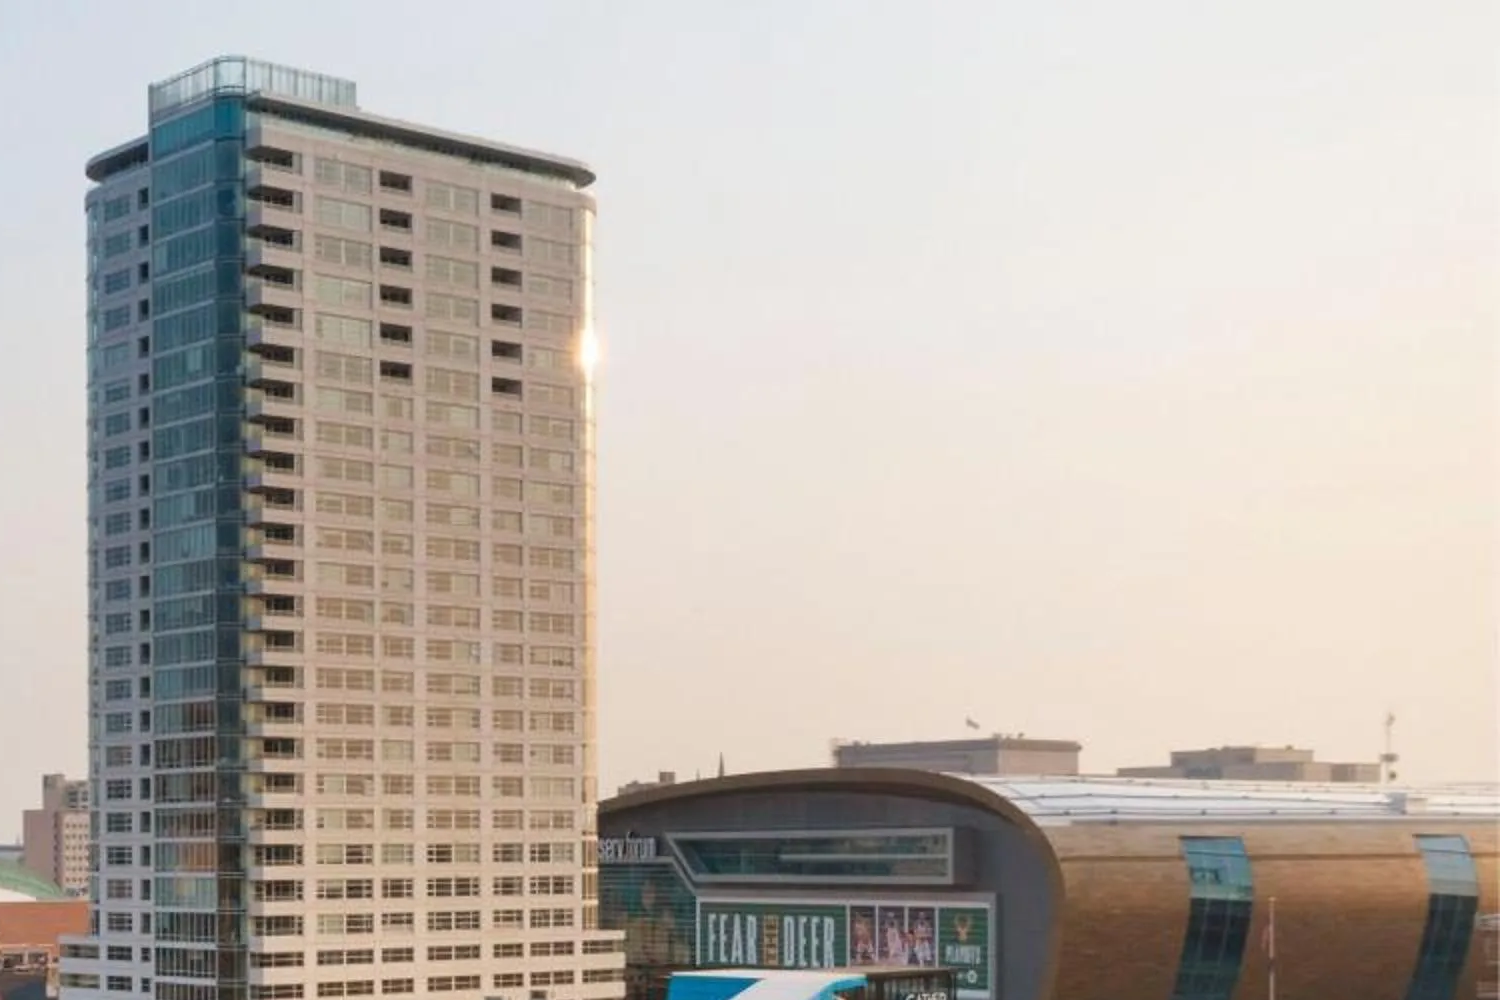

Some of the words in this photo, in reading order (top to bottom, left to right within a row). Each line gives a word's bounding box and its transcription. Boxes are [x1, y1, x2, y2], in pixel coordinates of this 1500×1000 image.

[707, 912, 757, 965] FEAR
[763, 916, 779, 966] THE
[783, 915, 835, 968] DEER
